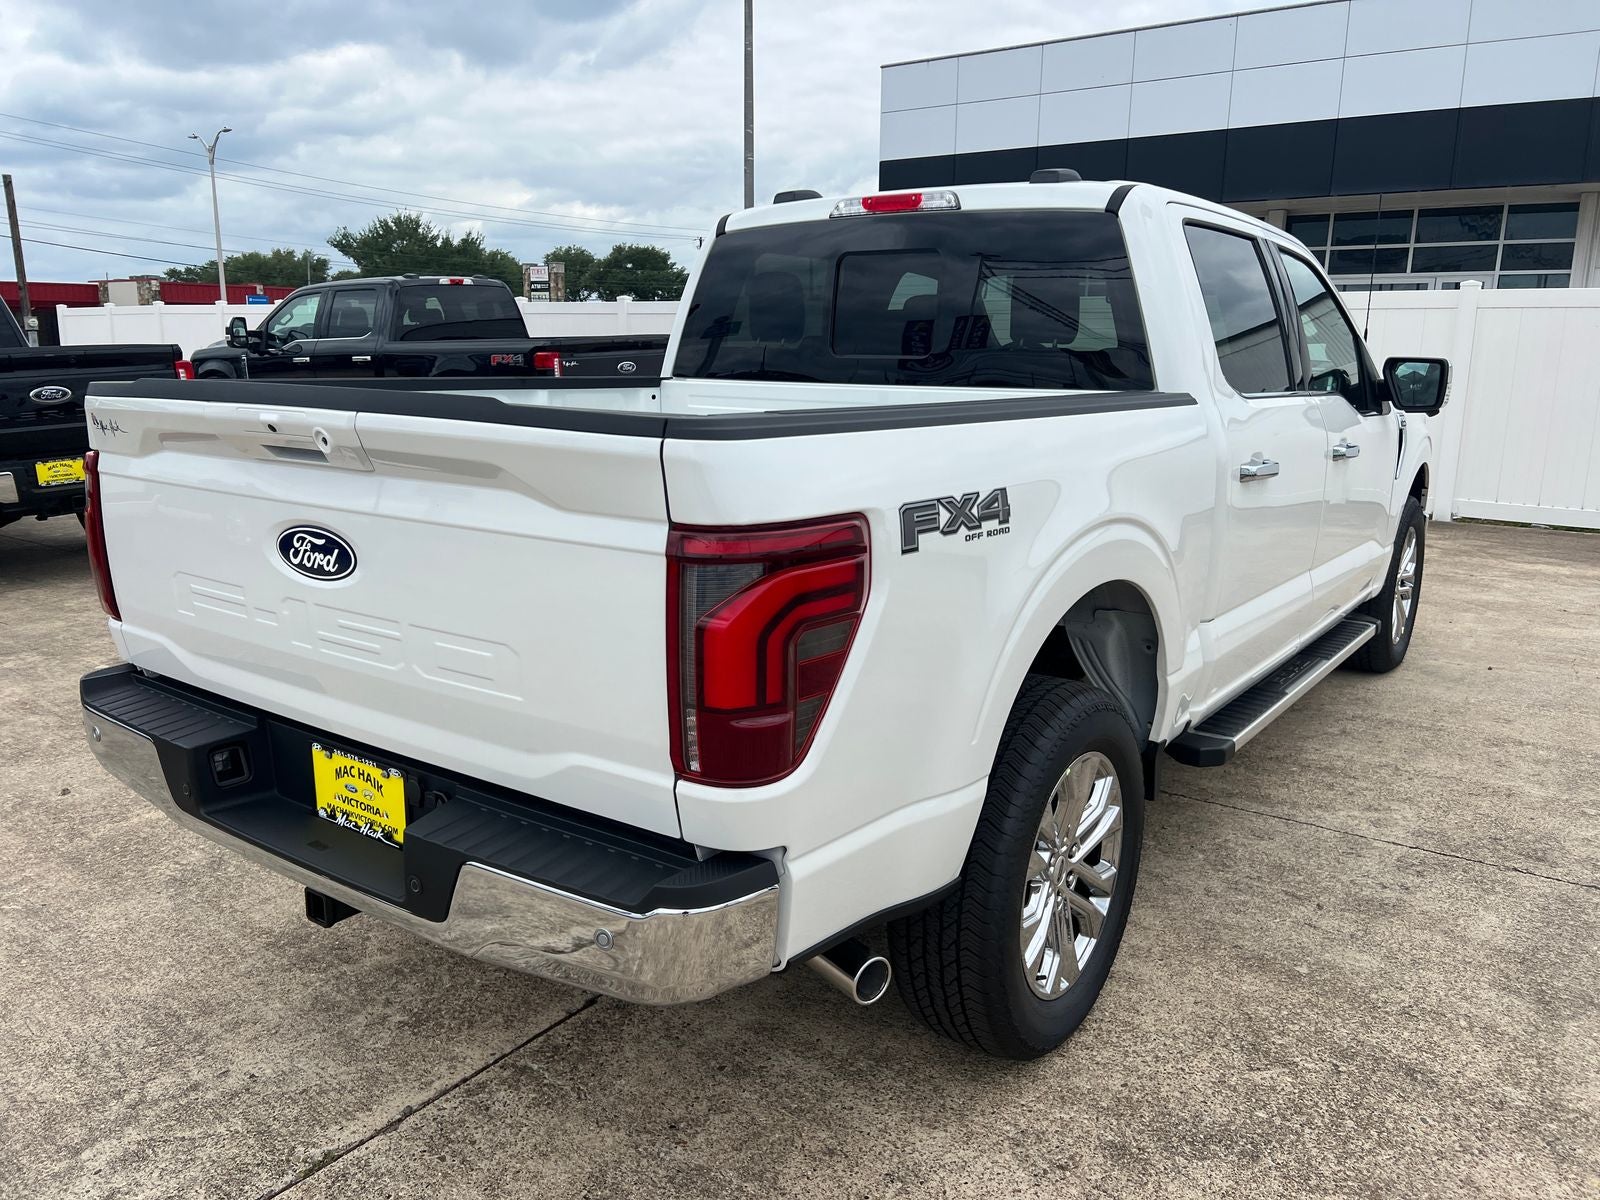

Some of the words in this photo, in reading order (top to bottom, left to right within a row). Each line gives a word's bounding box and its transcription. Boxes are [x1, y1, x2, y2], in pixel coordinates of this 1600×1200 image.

[491, 354, 524, 366] FX4
[899, 486, 1010, 556] FX4
[964, 531, 984, 542] OFF
[986, 526, 1010, 538] ROAD
[335, 765, 355, 781] MAC
[358, 767, 384, 798] HAIK
[340, 794, 381, 818] VICTORIA
[335, 812, 359, 831] Mac
[360, 823, 400, 849] Haik
